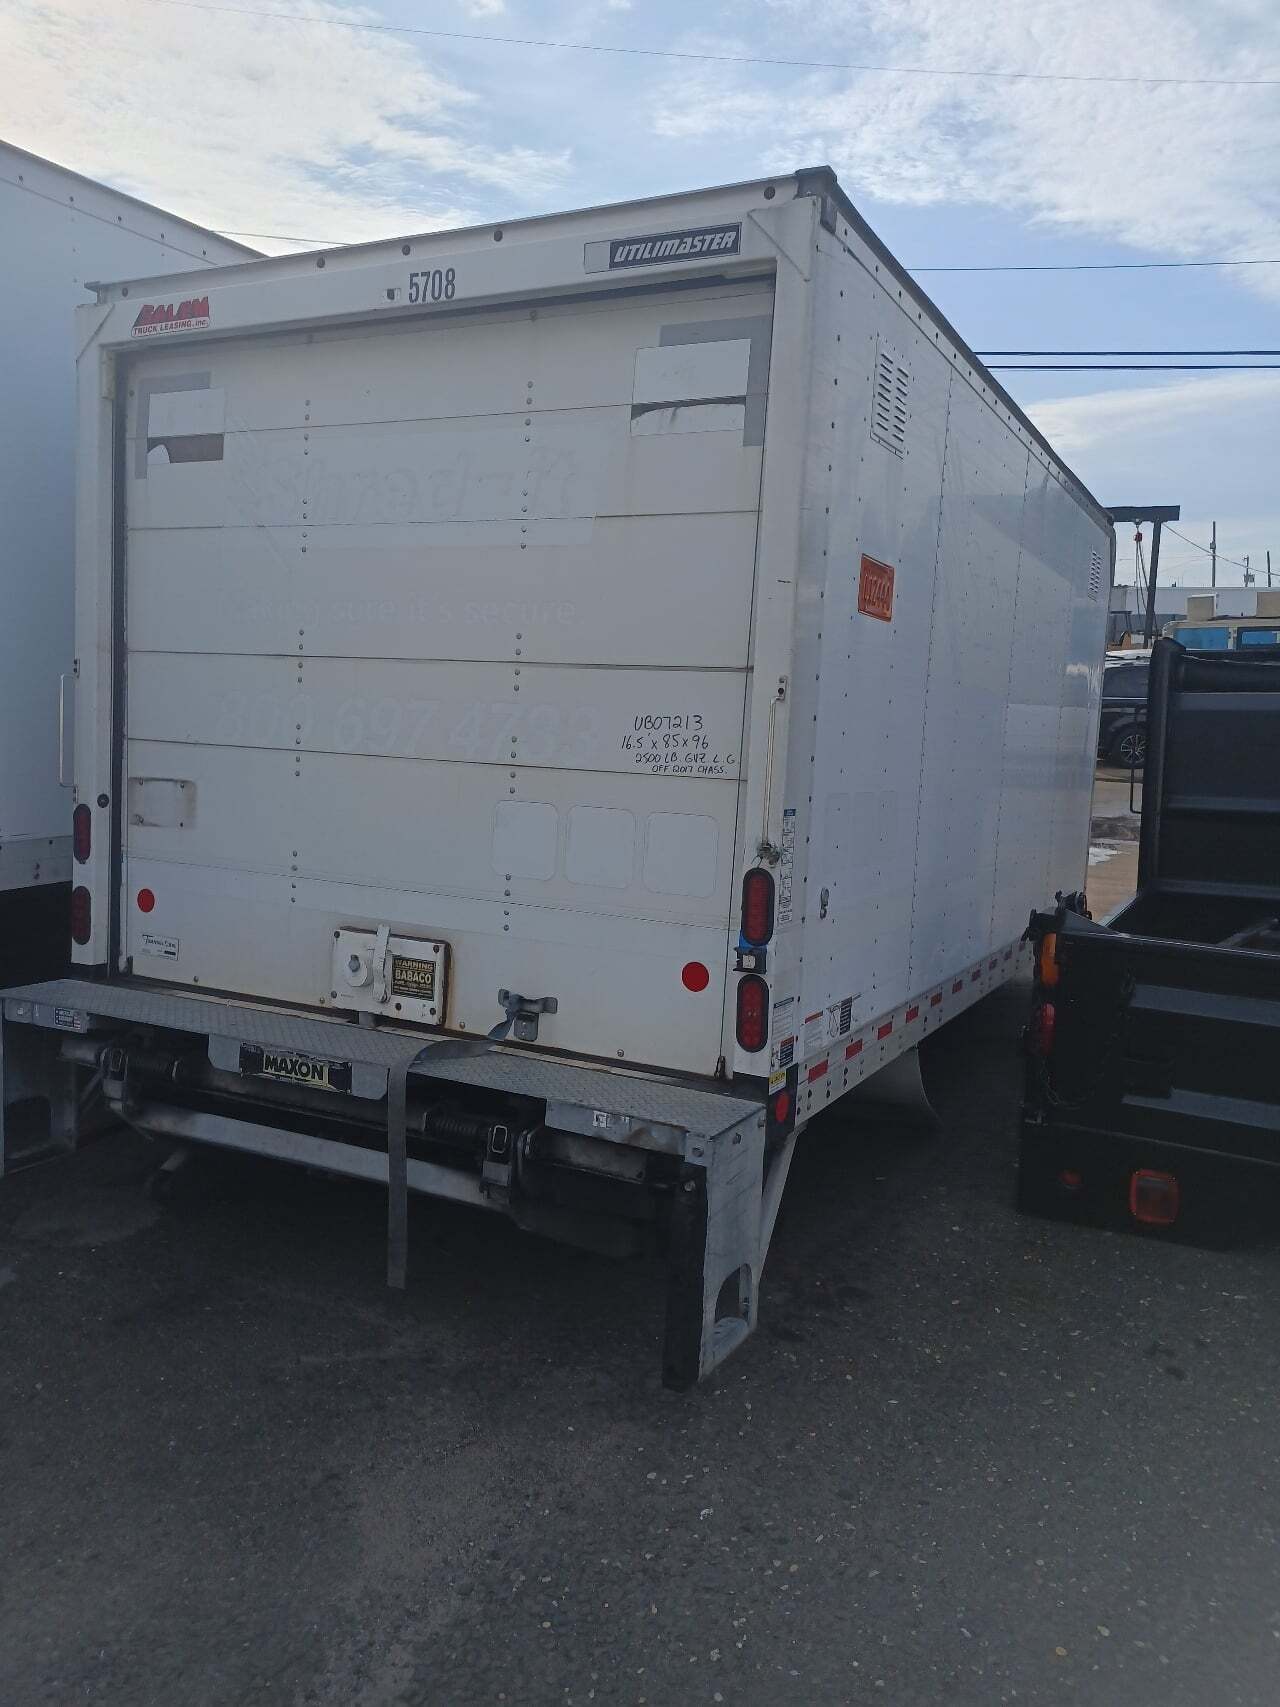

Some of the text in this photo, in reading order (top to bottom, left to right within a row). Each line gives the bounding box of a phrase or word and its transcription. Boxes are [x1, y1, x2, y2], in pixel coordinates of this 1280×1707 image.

[614, 231, 737, 263] UTILIMASTER
[408, 267, 456, 304] 5708
[133, 325, 158, 335] TRUCK
[394, 958, 433, 971] WARNING
[395, 969, 432, 985] BABACO
[264, 1054, 324, 1081] MAXON
